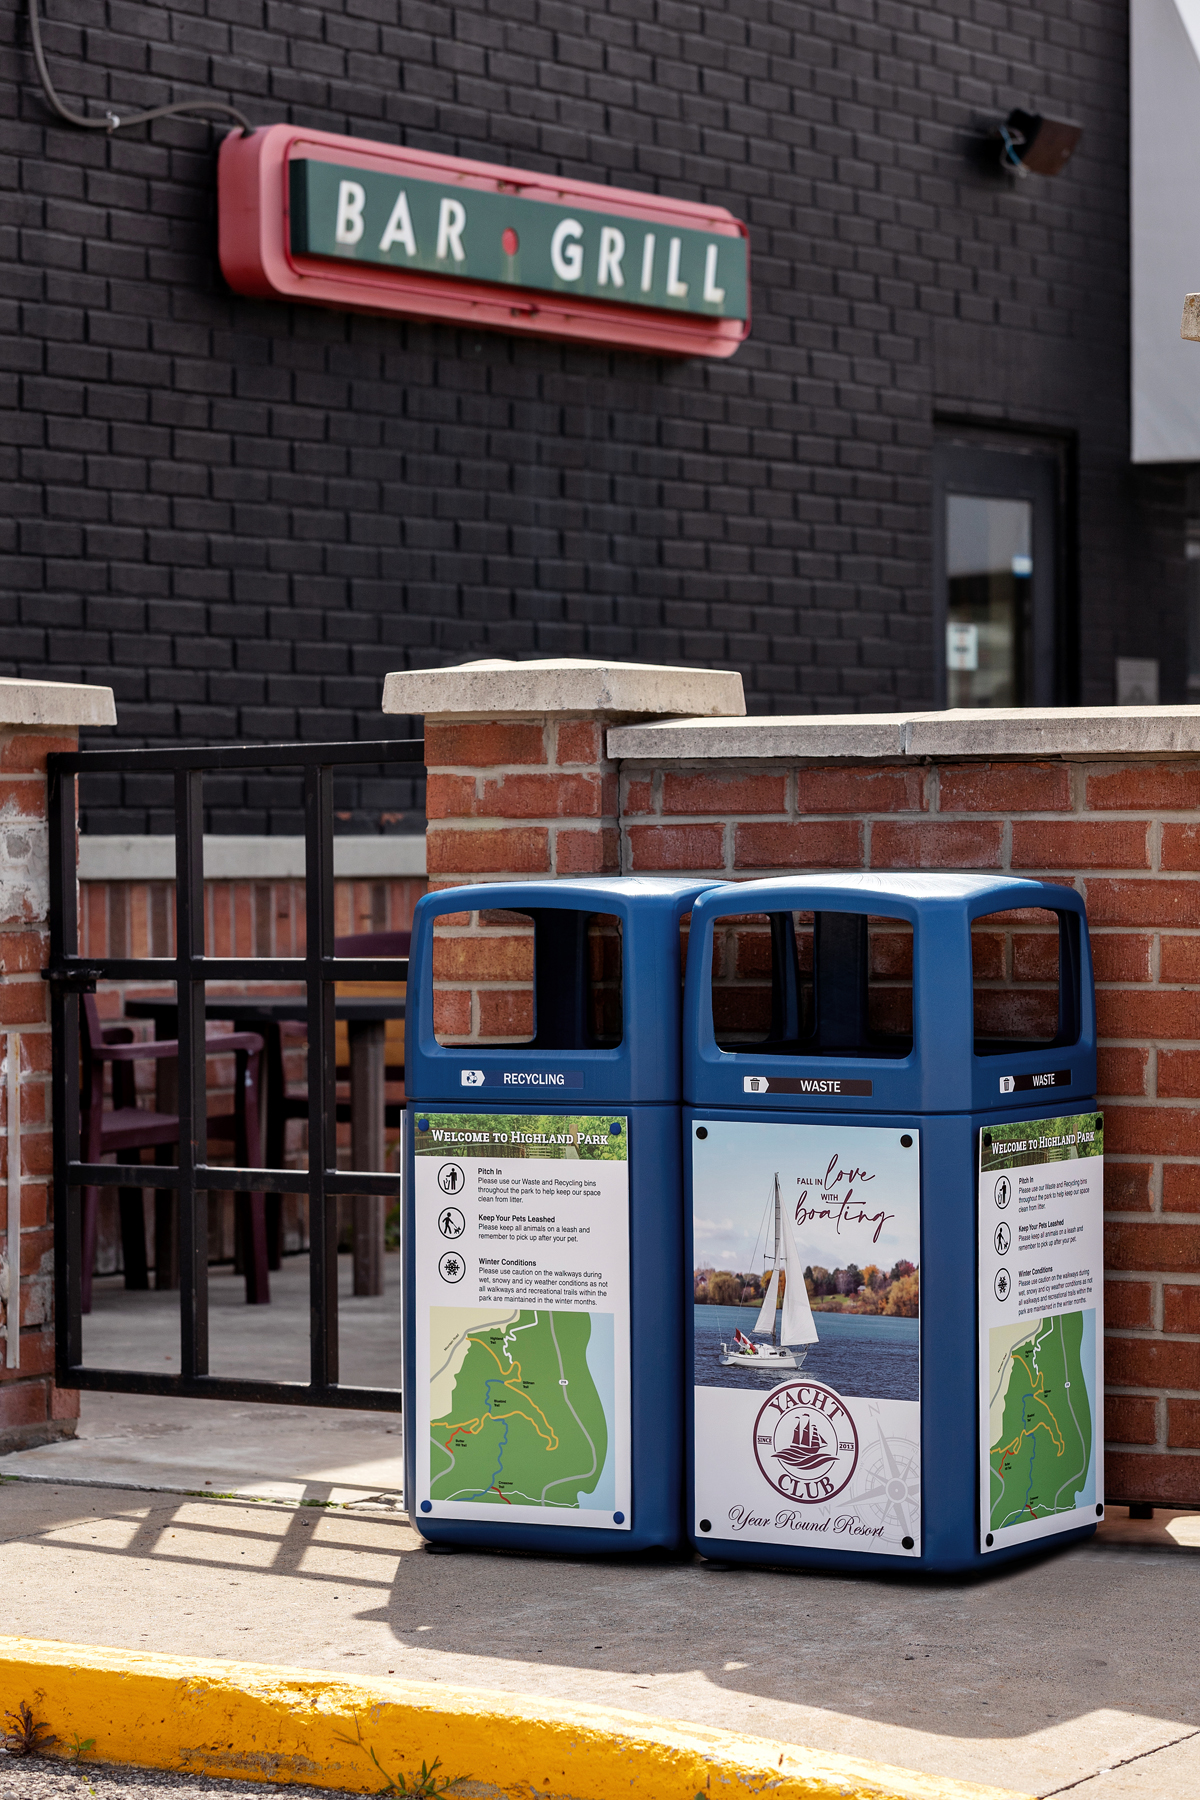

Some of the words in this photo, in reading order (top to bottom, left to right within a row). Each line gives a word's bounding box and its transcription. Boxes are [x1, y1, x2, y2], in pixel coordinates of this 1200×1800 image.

[335, 180, 467, 262] BAR
[550, 218, 726, 302] GRILL
[503, 1073, 565, 1085] RECYCLING
[1032, 1073, 1055, 1086] WASTE
[800, 1080, 841, 1093] WASTE
[824, 1154, 875, 1190] love
[554, 1178, 582, 1188] Recycling
[477, 1186, 508, 1195] throughout
[520, 1187, 534, 1196] park
[542, 1188, 555, 1196] help
[556, 1188, 570, 1197] keep
[478, 1214, 494, 1223] Keep
[795, 1188, 895, 1243] boating
[499, 1224, 513, 1233] keep
[516, 1234, 528, 1242] pick
[566, 1235, 578, 1244] pet.
[554, 1269, 582, 1278] walkways
[582, 1270, 602, 1279] during
[524, 1278, 532, 1286] icy
[486, 1286, 514, 1295] walkways
[478, 1294, 492, 1303] park
[768, 1388, 845, 1422] YACHT
[777, 1473, 835, 1499] CLUB
[728, 1504, 770, 1530] Year
[774, 1509, 830, 1533] Round
[833, 1514, 884, 1537] Resort
